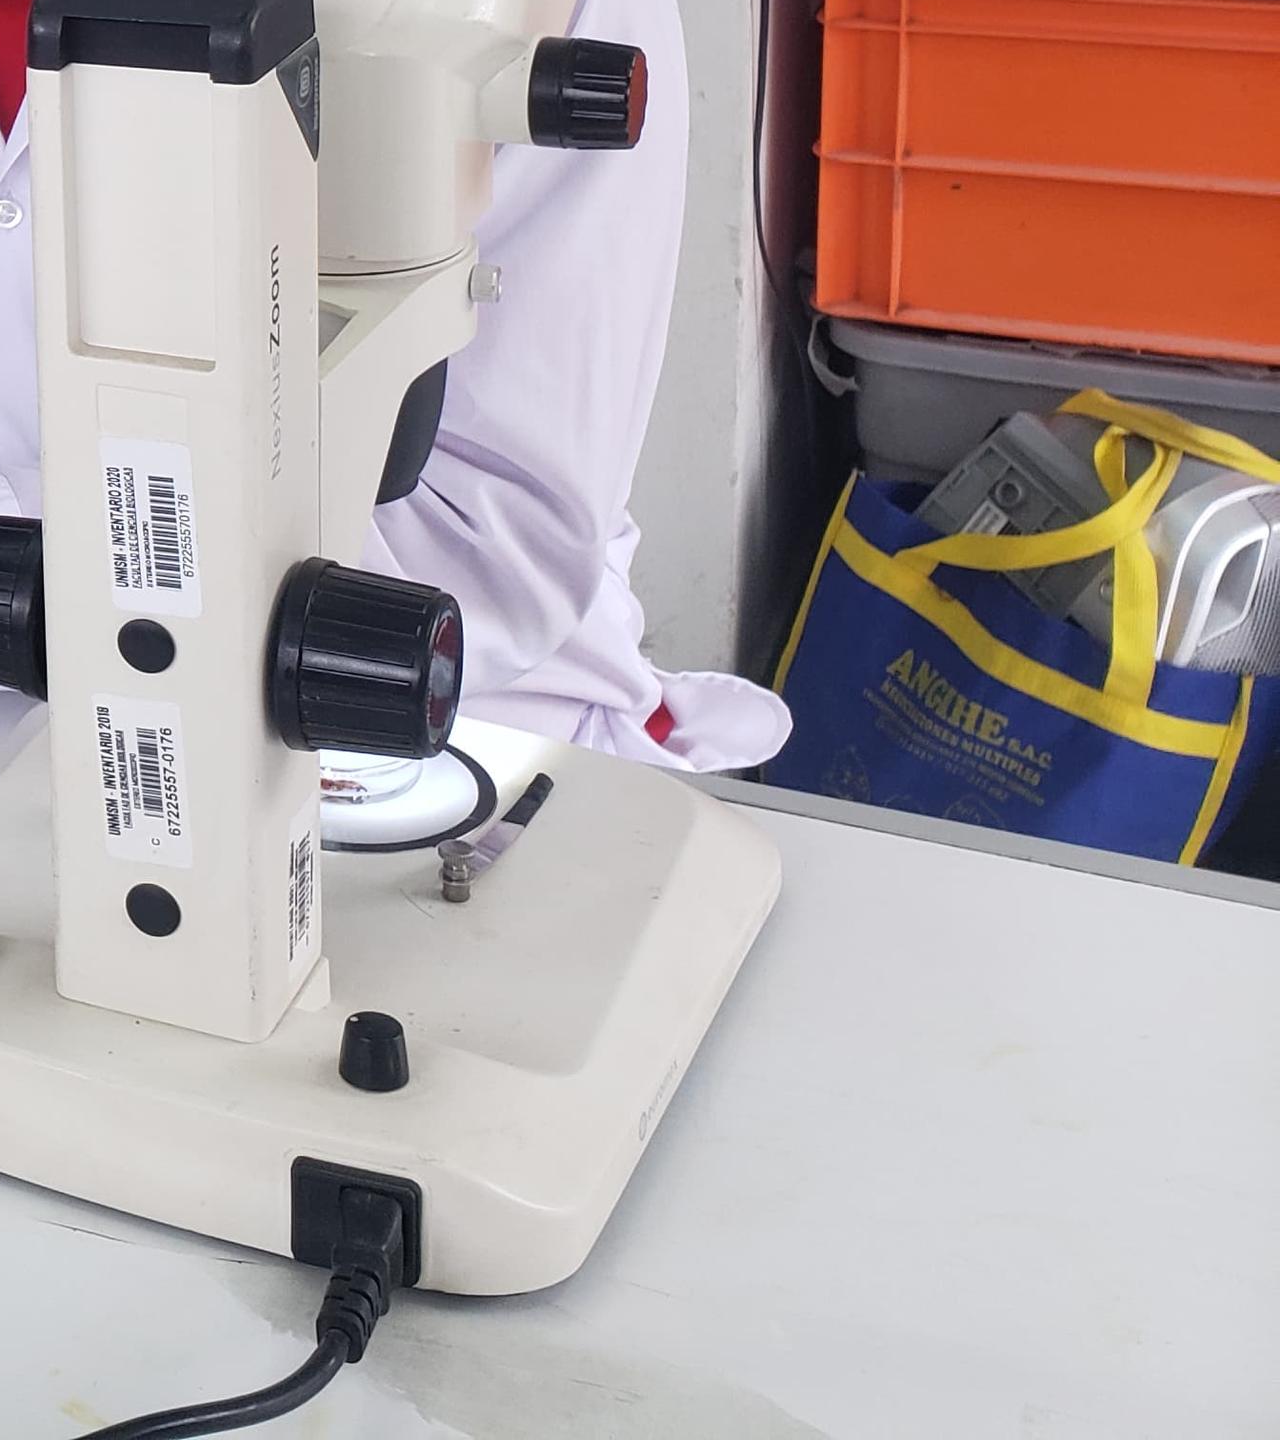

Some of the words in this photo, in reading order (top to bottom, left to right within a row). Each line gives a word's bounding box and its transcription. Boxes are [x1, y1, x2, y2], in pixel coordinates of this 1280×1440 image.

[269, 244, 282, 480] NexiusZoom
[106, 467, 121, 488] 2020
[123, 467, 135, 509] BIOLOGICAS
[108, 490, 126, 546] INVENTARIO
[177, 494, 194, 578] 672255570176
[129, 542, 139, 552] DE
[113, 553, 129, 588] UNMSM
[130, 553, 142, 589] FACULTAD
[99, 732, 116, 790] INVENTARIO
[159, 728, 181, 836] 67225557-0176
[105, 798, 121, 836] UNMSM
